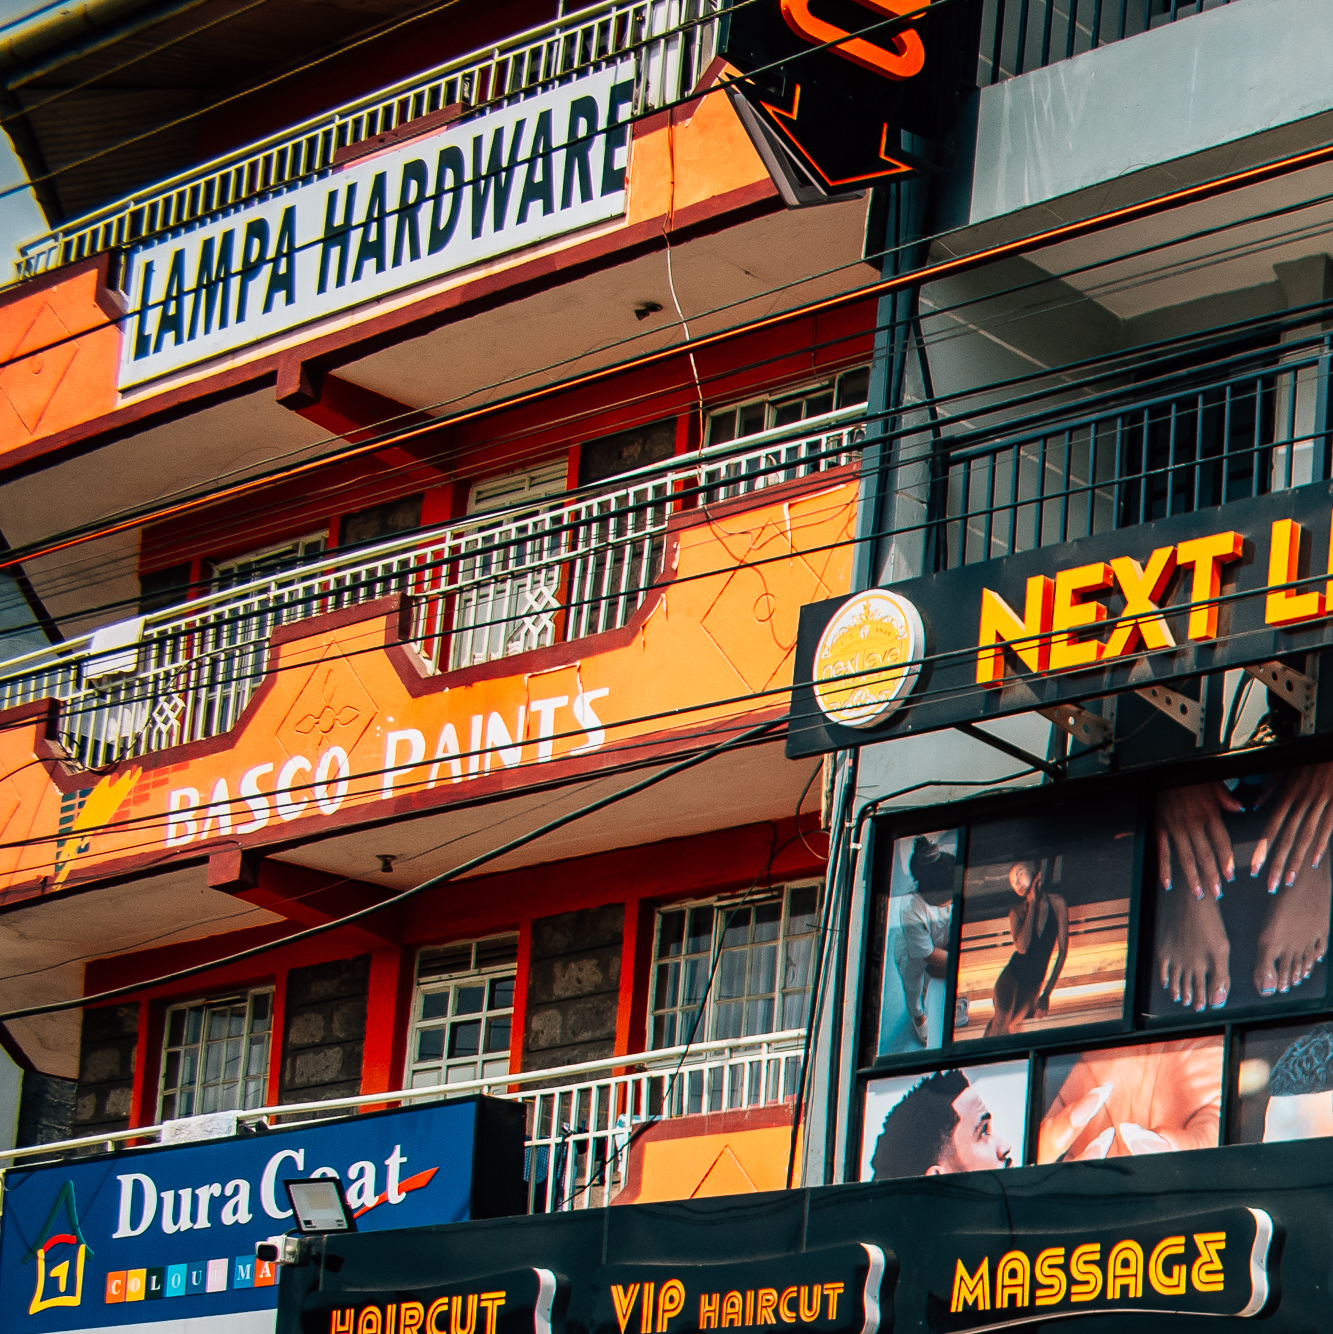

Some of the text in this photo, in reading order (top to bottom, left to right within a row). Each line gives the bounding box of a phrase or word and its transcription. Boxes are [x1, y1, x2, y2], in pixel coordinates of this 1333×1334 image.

[134, 79, 635, 360] LAMPA HARDWARE
[976, 531, 1243, 689] NEXT
[164, 686, 609, 847] BASCO PAINTS
[112, 1143, 409, 1240] DuraCat
[698, 1282, 845, 1331] HAIRCUT
[950, 1231, 1226, 1313] MASSAGE
